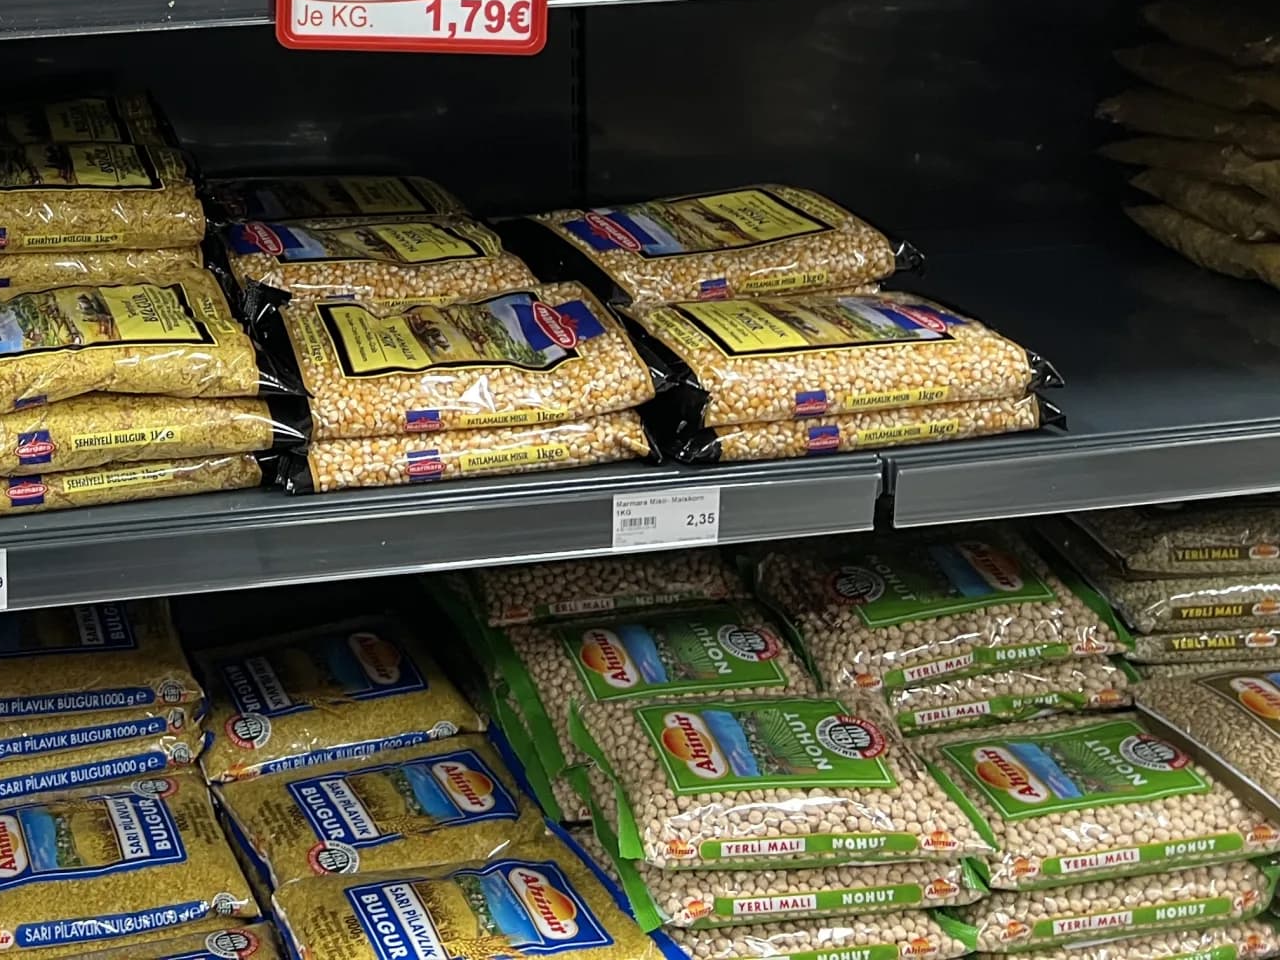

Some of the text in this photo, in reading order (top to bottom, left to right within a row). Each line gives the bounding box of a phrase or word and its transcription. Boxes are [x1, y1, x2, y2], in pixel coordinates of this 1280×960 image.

[297, 5, 374, 28] Je KG.
[687, 513, 715, 527] 2,35
[1215, 606, 1242, 616] MALI
[783, 712, 832, 770] NOHUT
[0, 781, 23, 795] SARI
[139, 763, 146, 772] g
[302, 787, 345, 839] BULGUR
[768, 841, 800, 852] MALI
[832, 838, 887, 849] NOHUT
[1105, 852, 1135, 864] MALI
[1165, 841, 1216, 856] NOHUT
[779, 898, 811, 909] MALI
[842, 890, 895, 904] NOHUT
